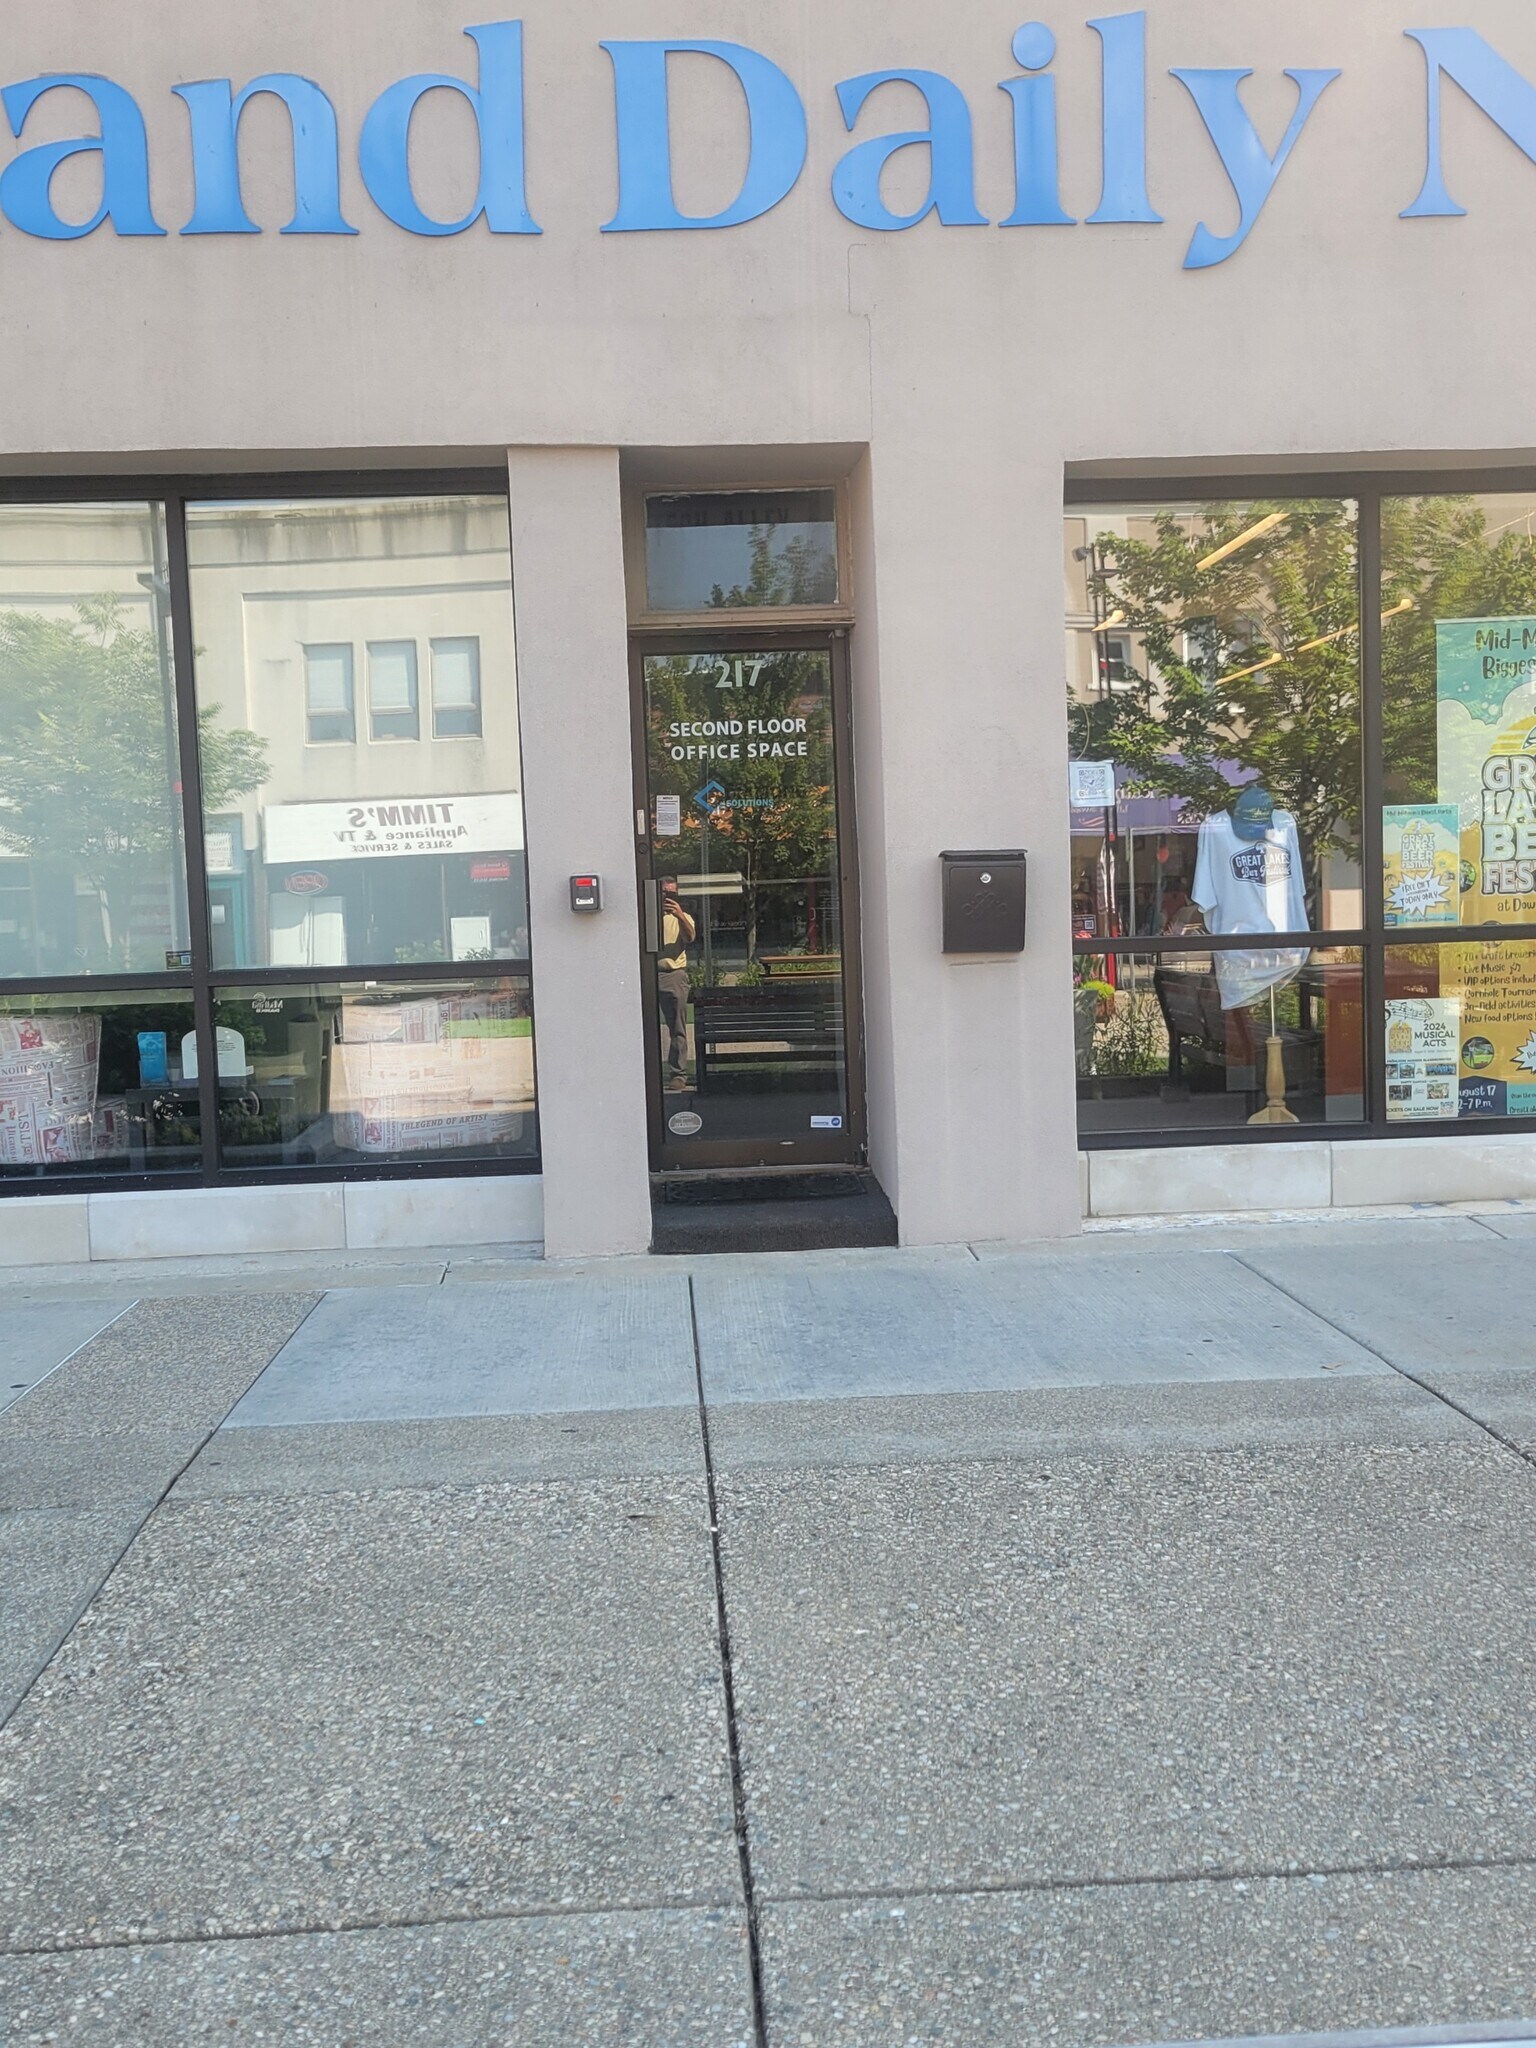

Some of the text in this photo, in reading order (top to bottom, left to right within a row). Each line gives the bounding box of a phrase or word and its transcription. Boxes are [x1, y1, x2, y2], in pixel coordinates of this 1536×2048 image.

[599, 10, 1342, 270] Daily
[1482, 655, 1536, 680] Bigges
[714, 660, 764, 689] 217
[670, 718, 807, 738] SECOND FLOOR
[671, 741, 808, 761] OFFICE SPACE
[726, 798, 774, 808] SOLUTIONS
[1402, 833, 1435, 843] GREAT
[1402, 842, 1434, 851] LAKES
[1235, 854, 1261, 868] GREAT
[1402, 851, 1433, 861] BEER
[1497, 899, 1536, 911] at Dow
[1464, 963, 1505, 974] Live Music
[1464, 976, 1479, 986] VIP
[1464, 988, 1499, 999] Cornhole
[1465, 1014, 1482, 1024] New
[1484, 1012, 1501, 1023] food
[1423, 1022, 1447, 1031] 2024
[1414, 1030, 1456, 1040] MUSICAL
[1422, 1039, 1447, 1048] ACTS
[1458, 1085, 1485, 1097] ugust
[1486, 1084, 1497, 1096] 17
[1458, 1099, 1473, 1110] 2-7
[445, 1115, 458, 1125] OF
[459, 1113, 488, 1124] ARTIST
